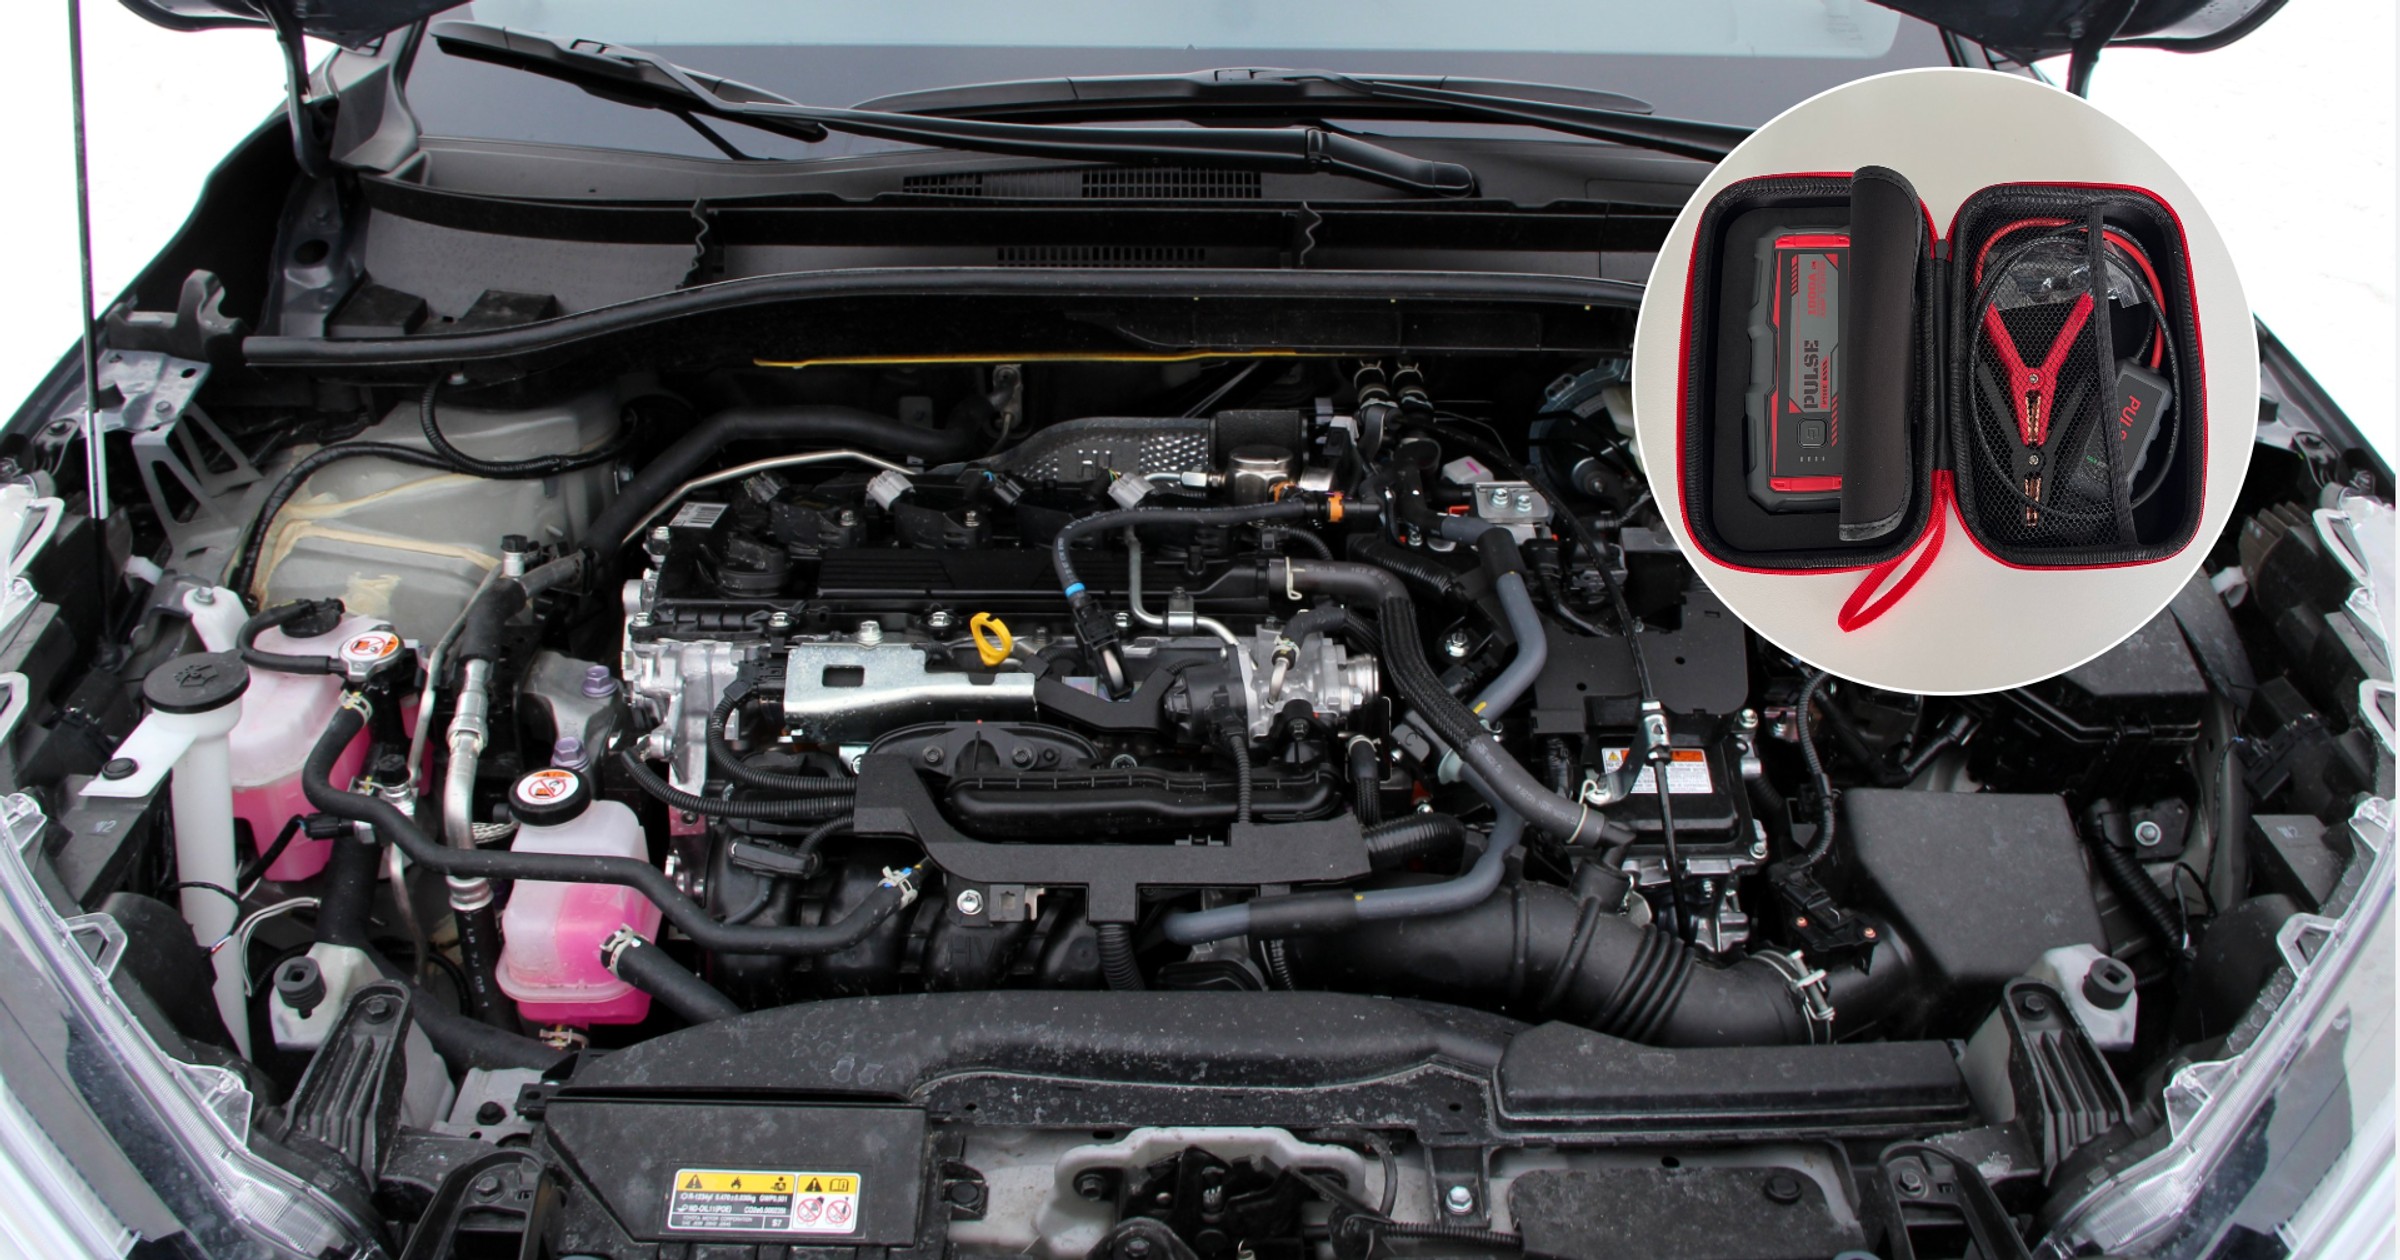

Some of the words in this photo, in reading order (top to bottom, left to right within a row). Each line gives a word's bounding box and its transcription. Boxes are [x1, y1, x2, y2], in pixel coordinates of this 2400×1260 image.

[1807, 273, 1817, 316] 1000A
[1803, 340, 1819, 409] PULSE
[772, 1219, 783, 1228] S7
